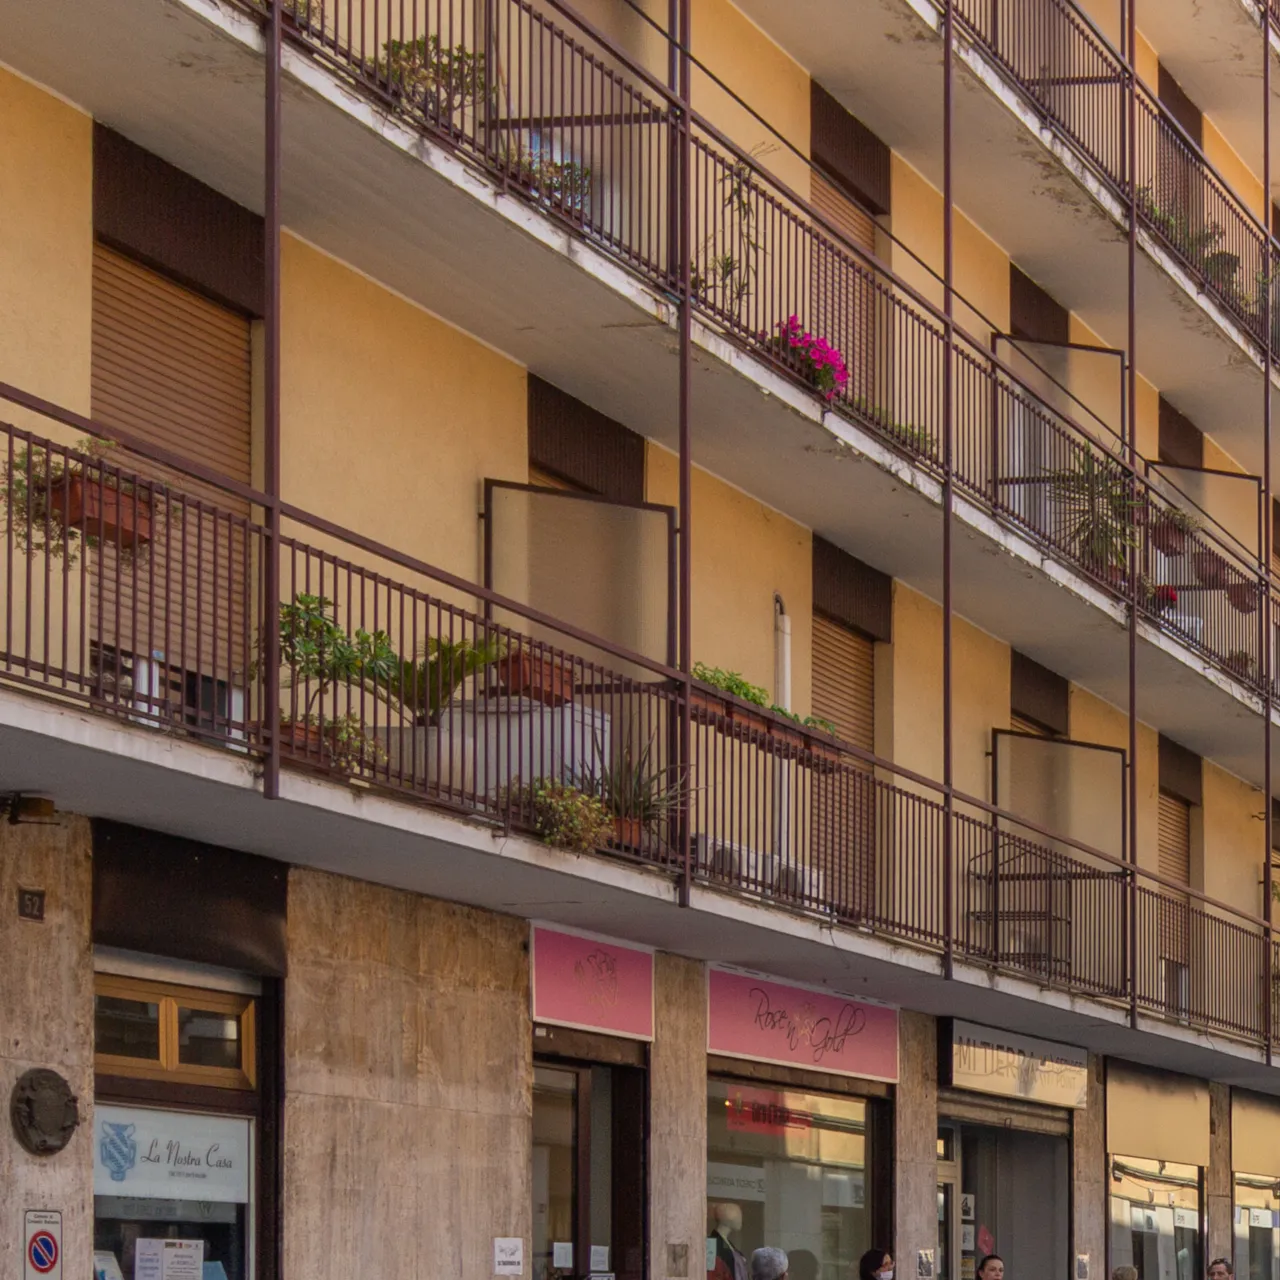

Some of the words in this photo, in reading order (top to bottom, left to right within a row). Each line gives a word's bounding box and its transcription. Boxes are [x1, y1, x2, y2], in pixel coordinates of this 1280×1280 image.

[24, 894, 40, 916] 52
[749, 987, 788, 1031] Rose
[810, 1003, 866, 1063] Gold
[140, 1138, 160, 1163] La
[166, 1139, 201, 1167] Nostra
[206, 1143, 233, 1169] Casa
